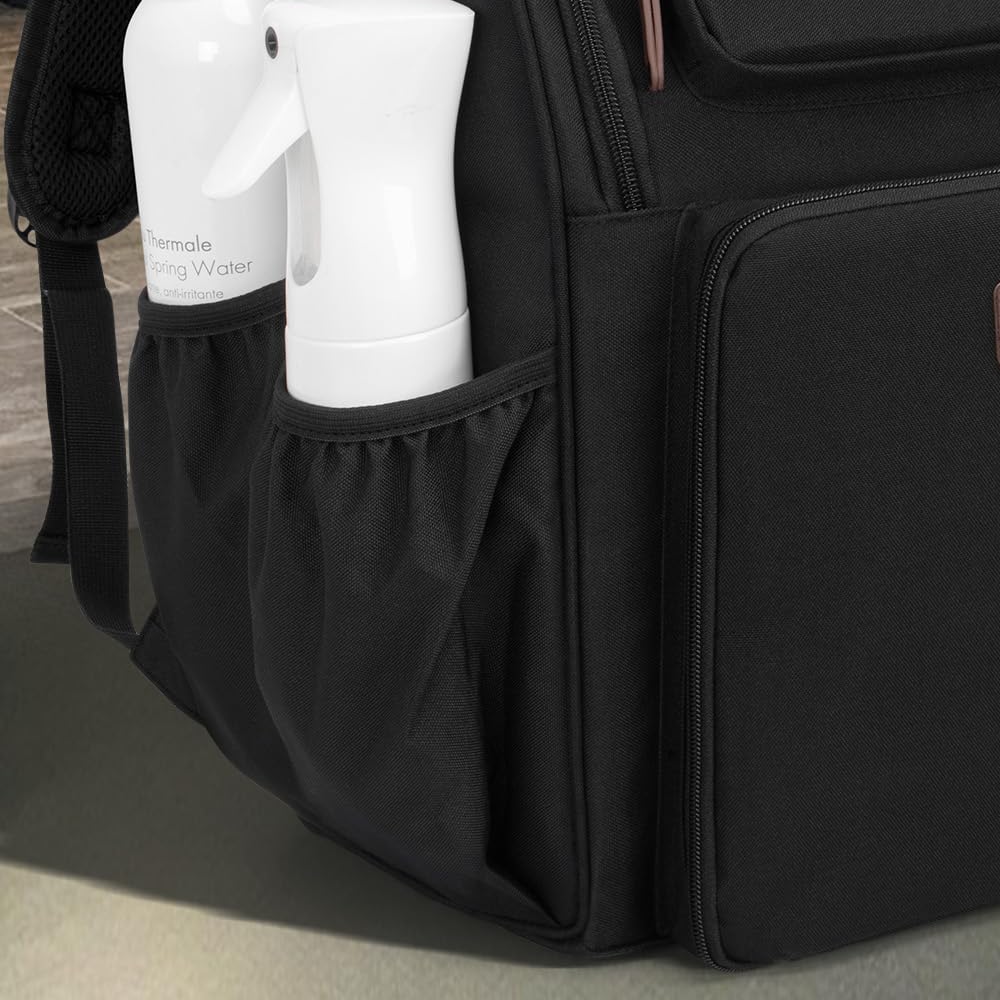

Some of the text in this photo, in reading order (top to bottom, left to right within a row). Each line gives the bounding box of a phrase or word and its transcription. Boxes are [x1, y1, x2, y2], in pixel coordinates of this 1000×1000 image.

[146, 229, 212, 253] Thermale
[149, 254, 254, 282] Spring Water
[164, 288, 224, 300] anti-irritante
